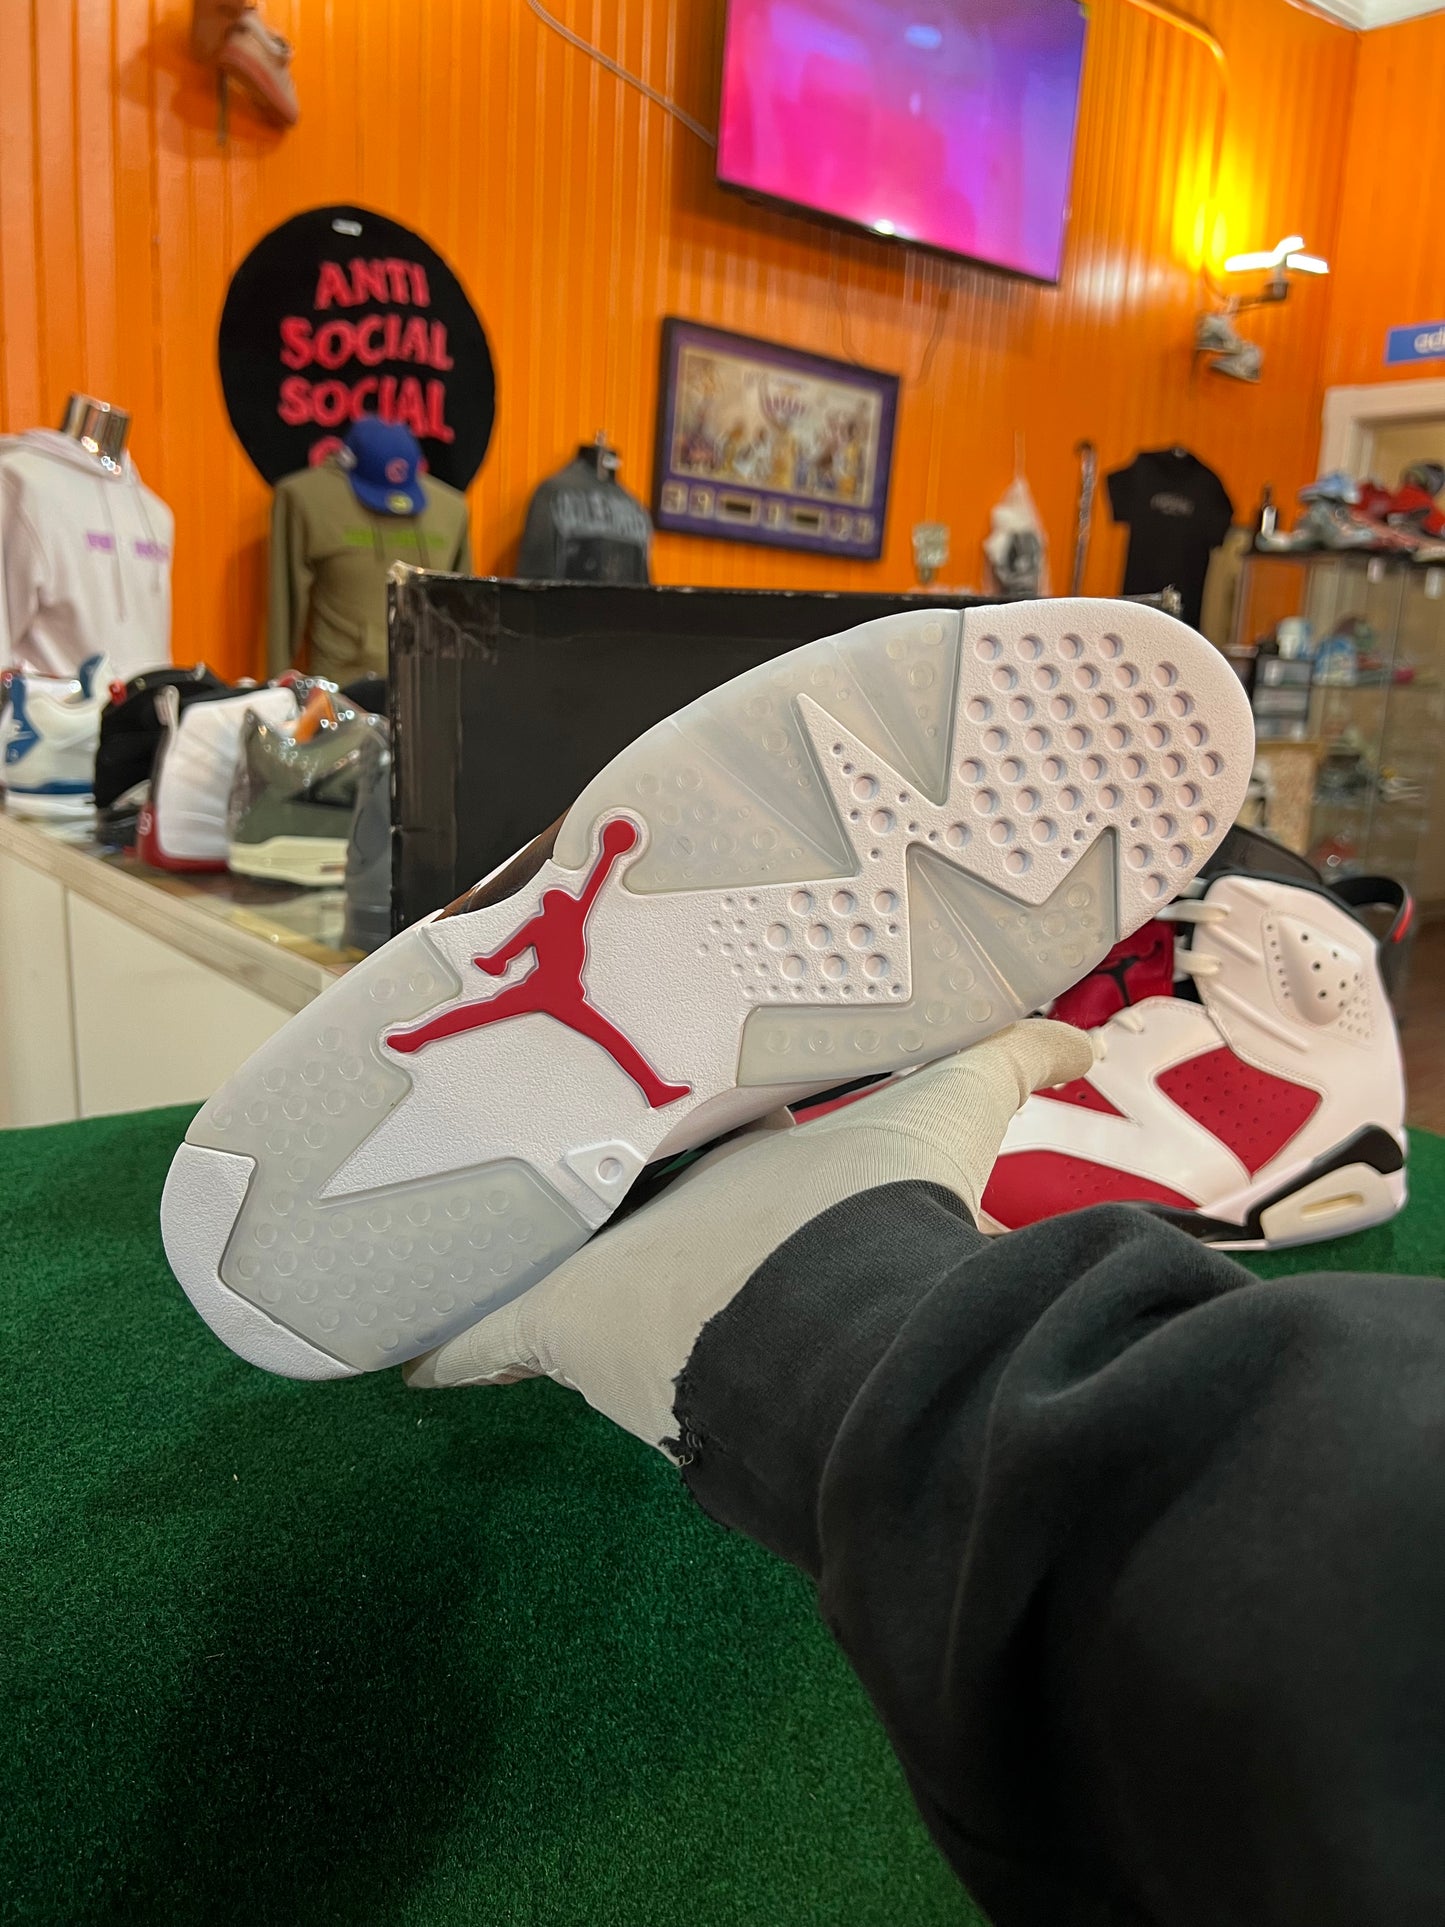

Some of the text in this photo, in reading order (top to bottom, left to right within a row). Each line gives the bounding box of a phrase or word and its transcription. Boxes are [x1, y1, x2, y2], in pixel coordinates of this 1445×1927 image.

[314, 257, 430, 310] ANTI
[279, 313, 454, 370] SOCIAL
[277, 375, 455, 443] SOCIAL
